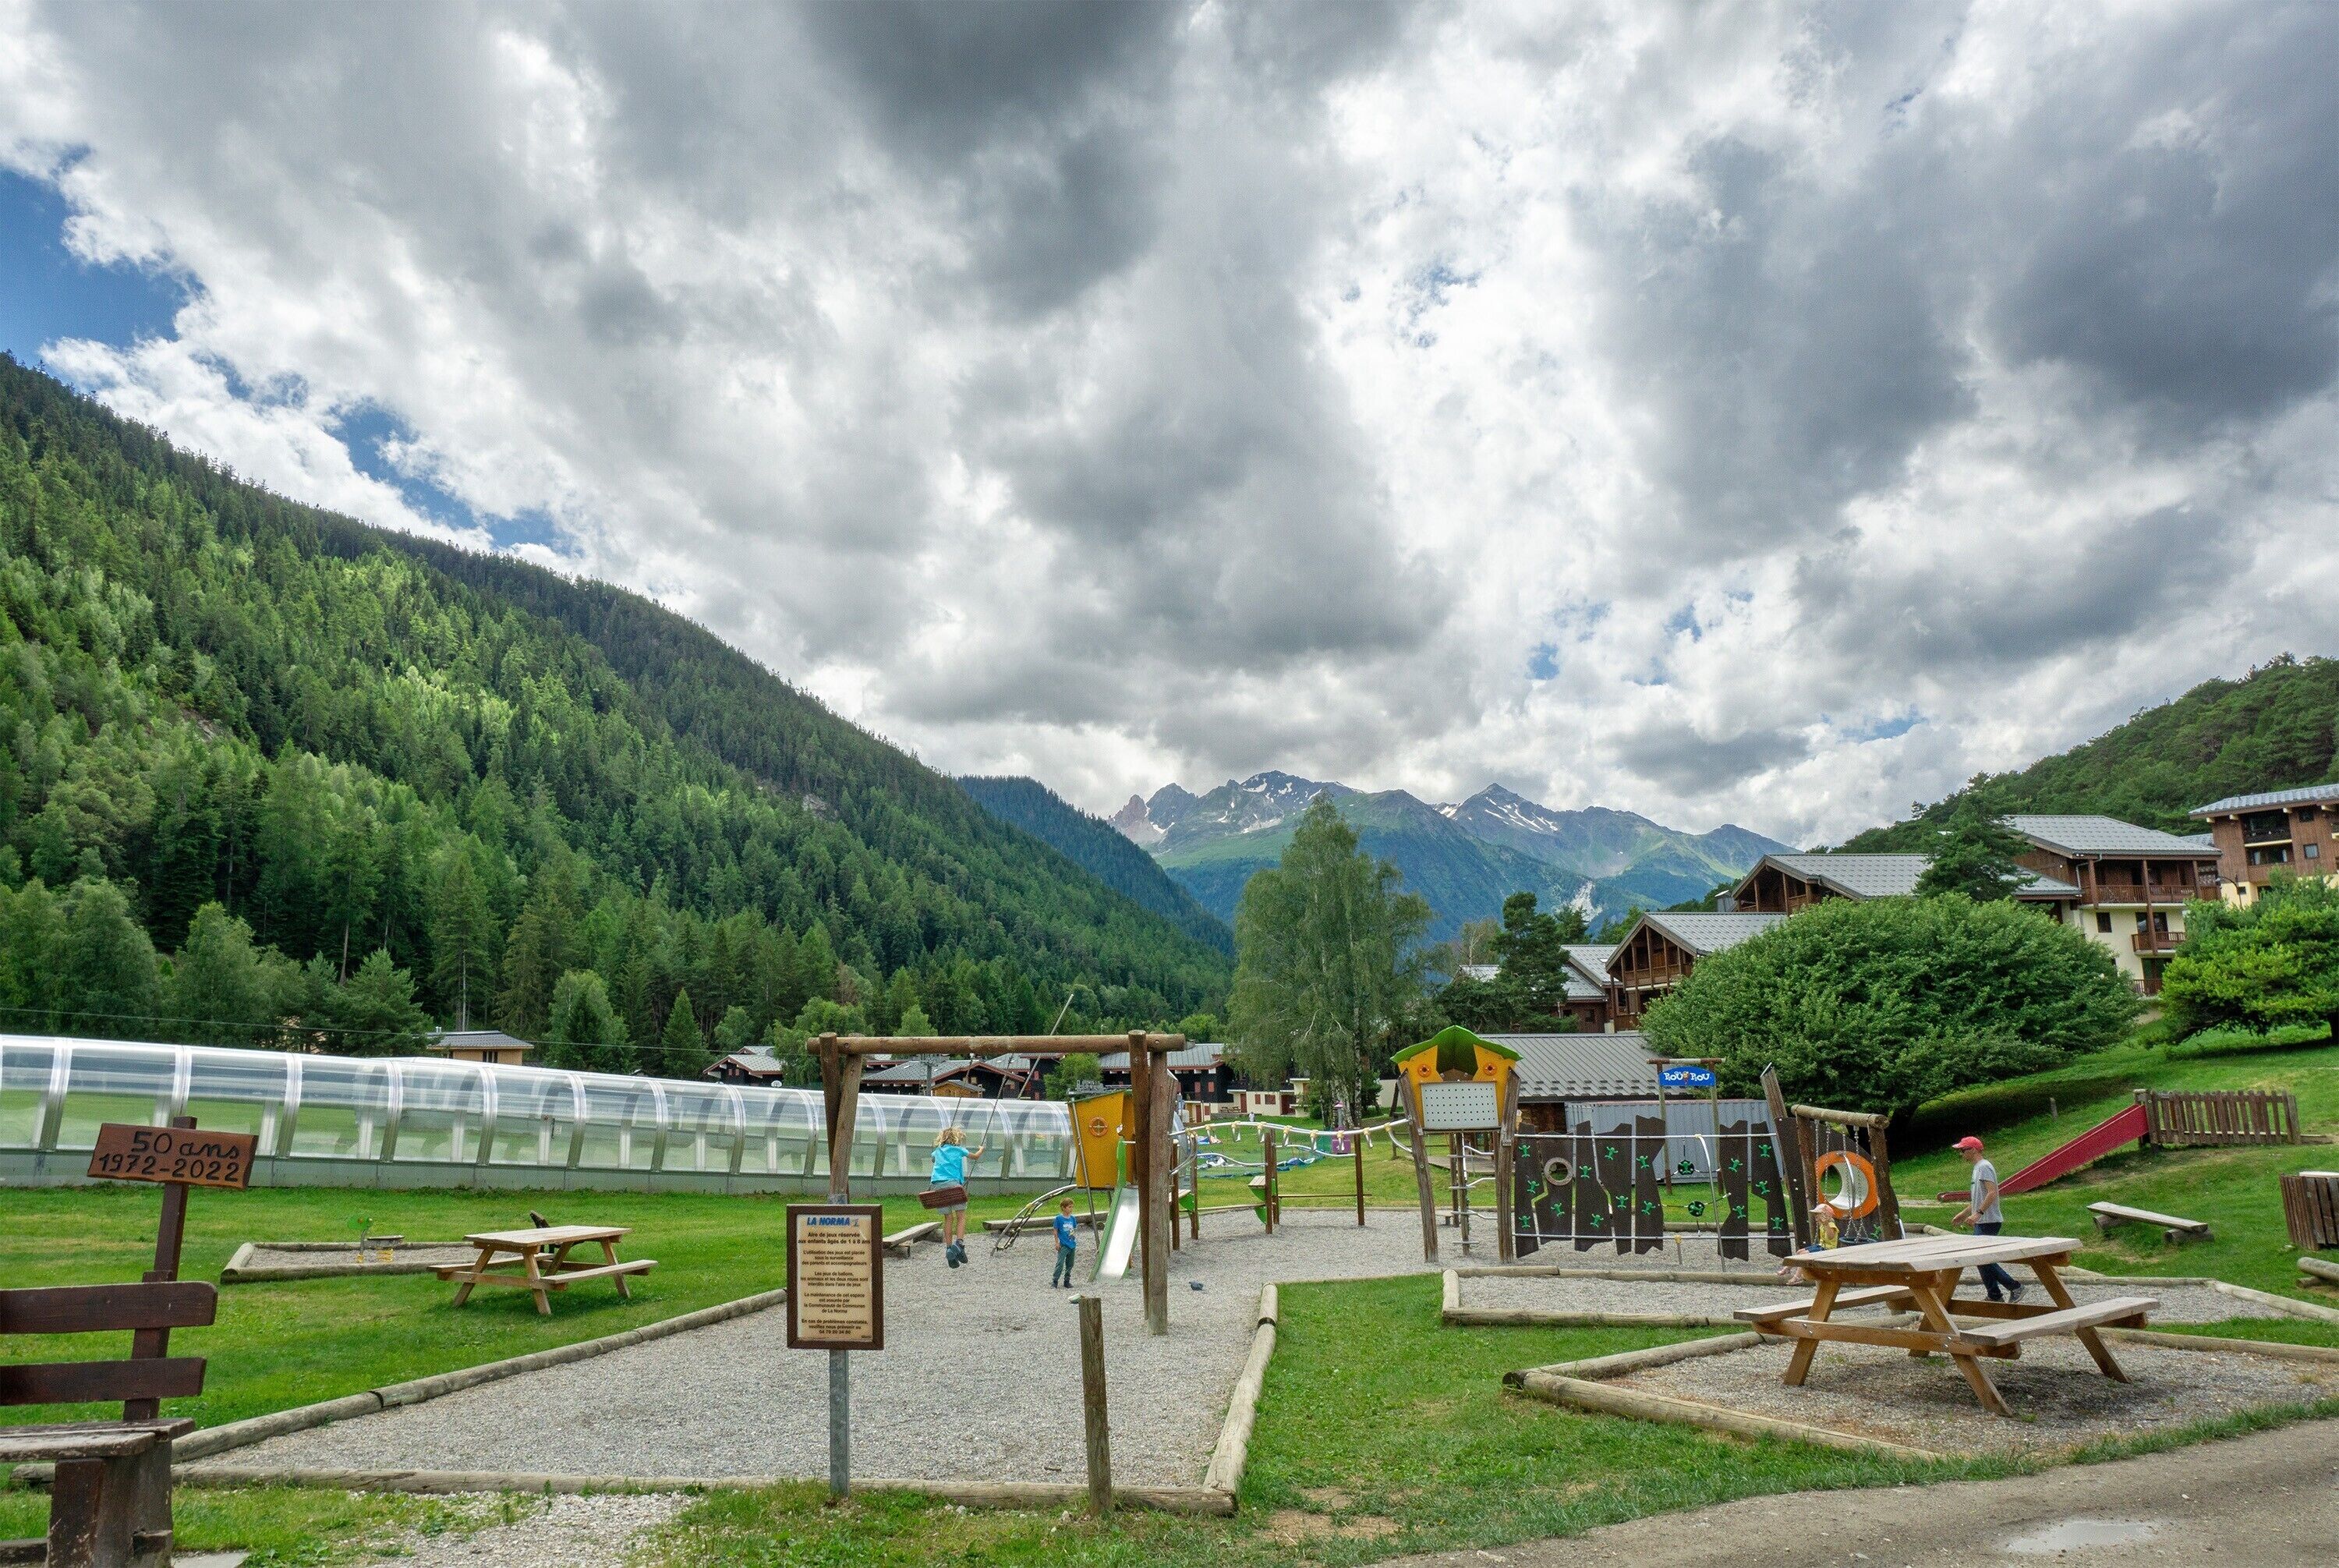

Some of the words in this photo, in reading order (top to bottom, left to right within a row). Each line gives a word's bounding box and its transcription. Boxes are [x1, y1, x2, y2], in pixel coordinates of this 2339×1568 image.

[131, 1131, 172, 1154] 50
[179, 1141, 240, 1159] ans
[99, 1153, 240, 1183] 1972-2022
